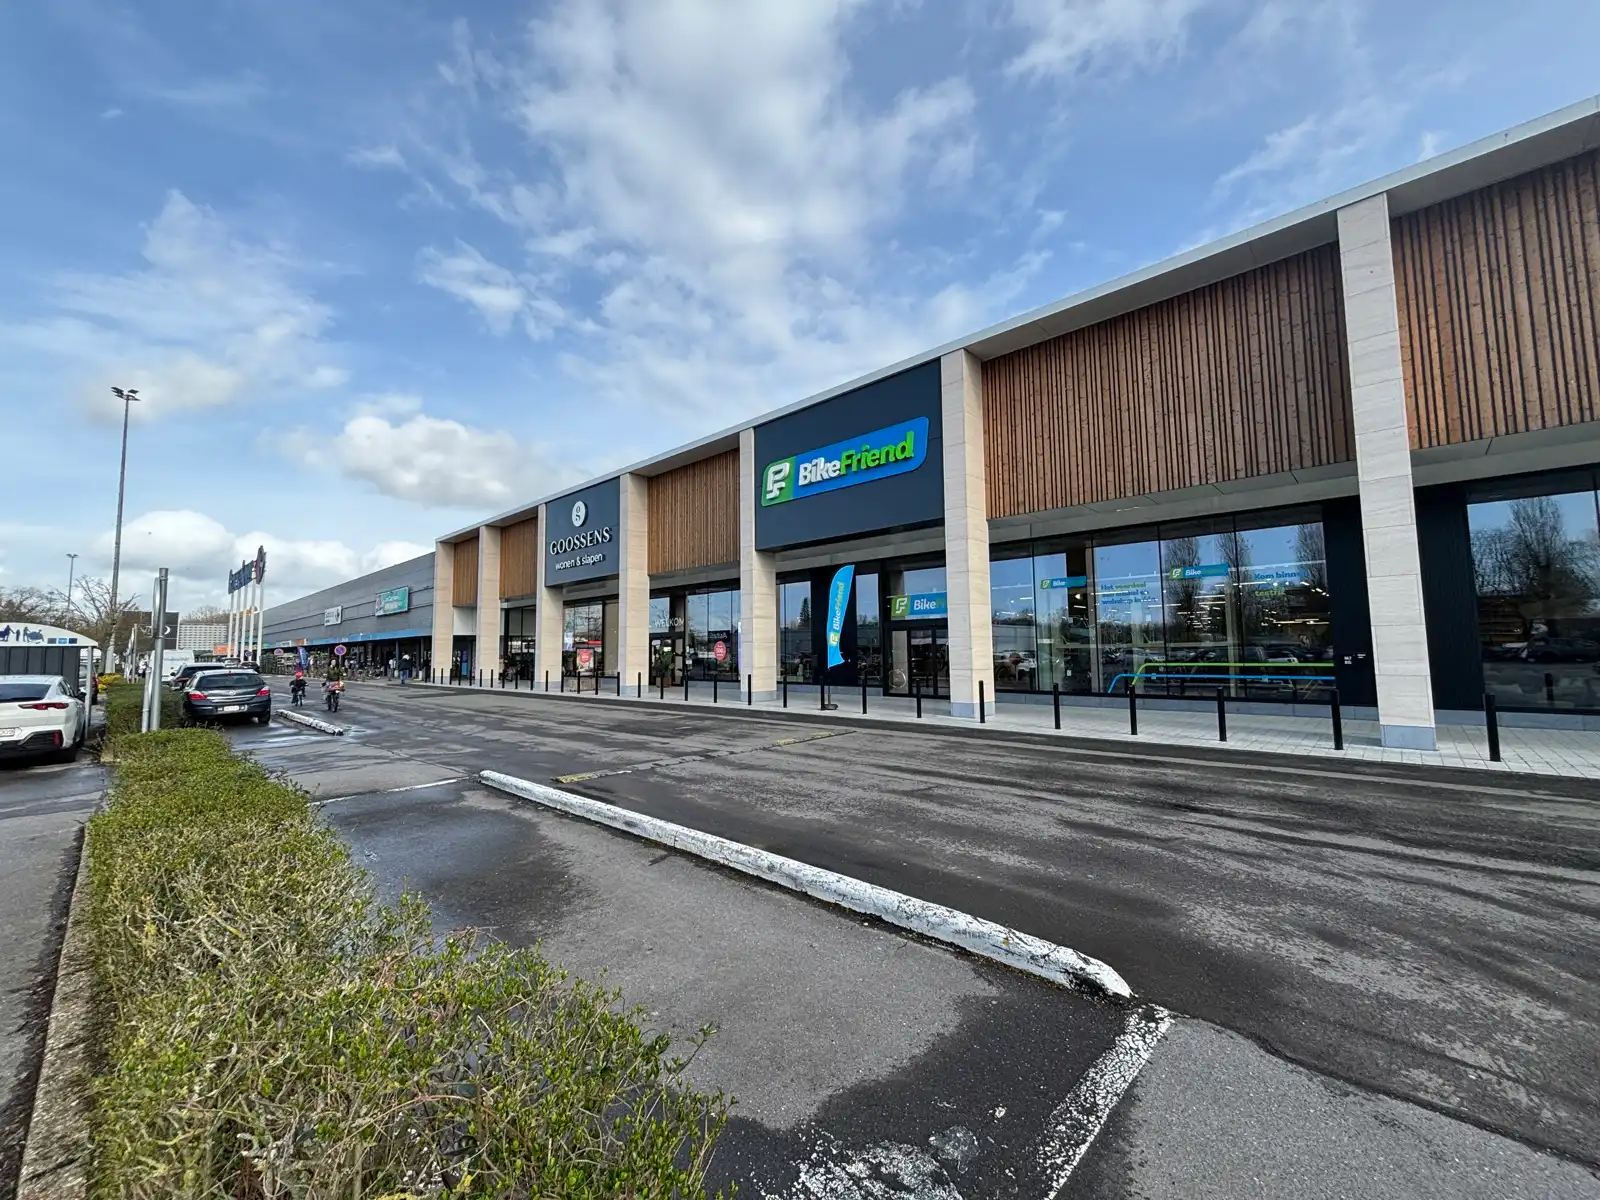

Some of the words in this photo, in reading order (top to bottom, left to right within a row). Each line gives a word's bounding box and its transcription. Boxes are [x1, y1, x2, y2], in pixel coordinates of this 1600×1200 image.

[798, 430, 915, 487] BikeFriend
[549, 526, 610, 556] GOOSSENS
[555, 559, 575, 571] wonen
[576, 556, 581, 566] &
[582, 553, 603, 566] slapen
